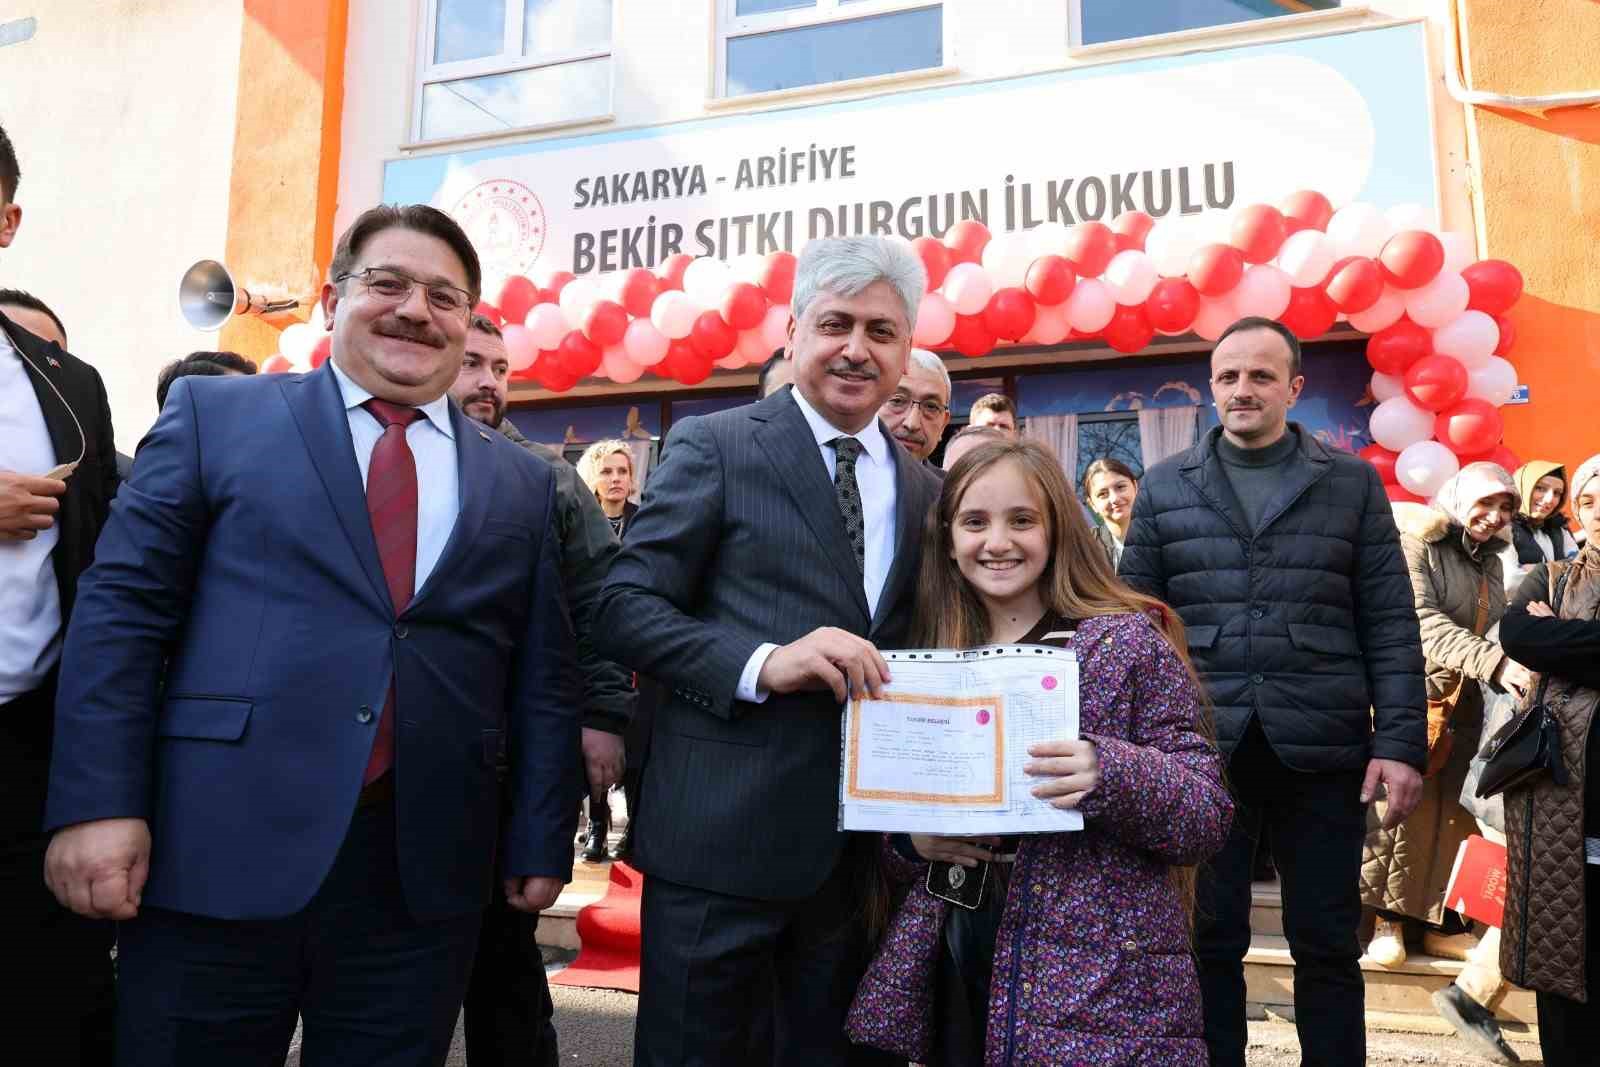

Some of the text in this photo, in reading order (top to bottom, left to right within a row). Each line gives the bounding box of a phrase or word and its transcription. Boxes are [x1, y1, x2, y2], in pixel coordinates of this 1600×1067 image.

[573, 164, 708, 209] SAKARYA
[734, 143, 856, 190] ARİFİYE
[573, 215, 684, 274] BEKİR
[695, 210, 793, 261] SITKI
[808, 188, 989, 241] DURGUN
[1005, 161, 1236, 231] İLKOKULU
